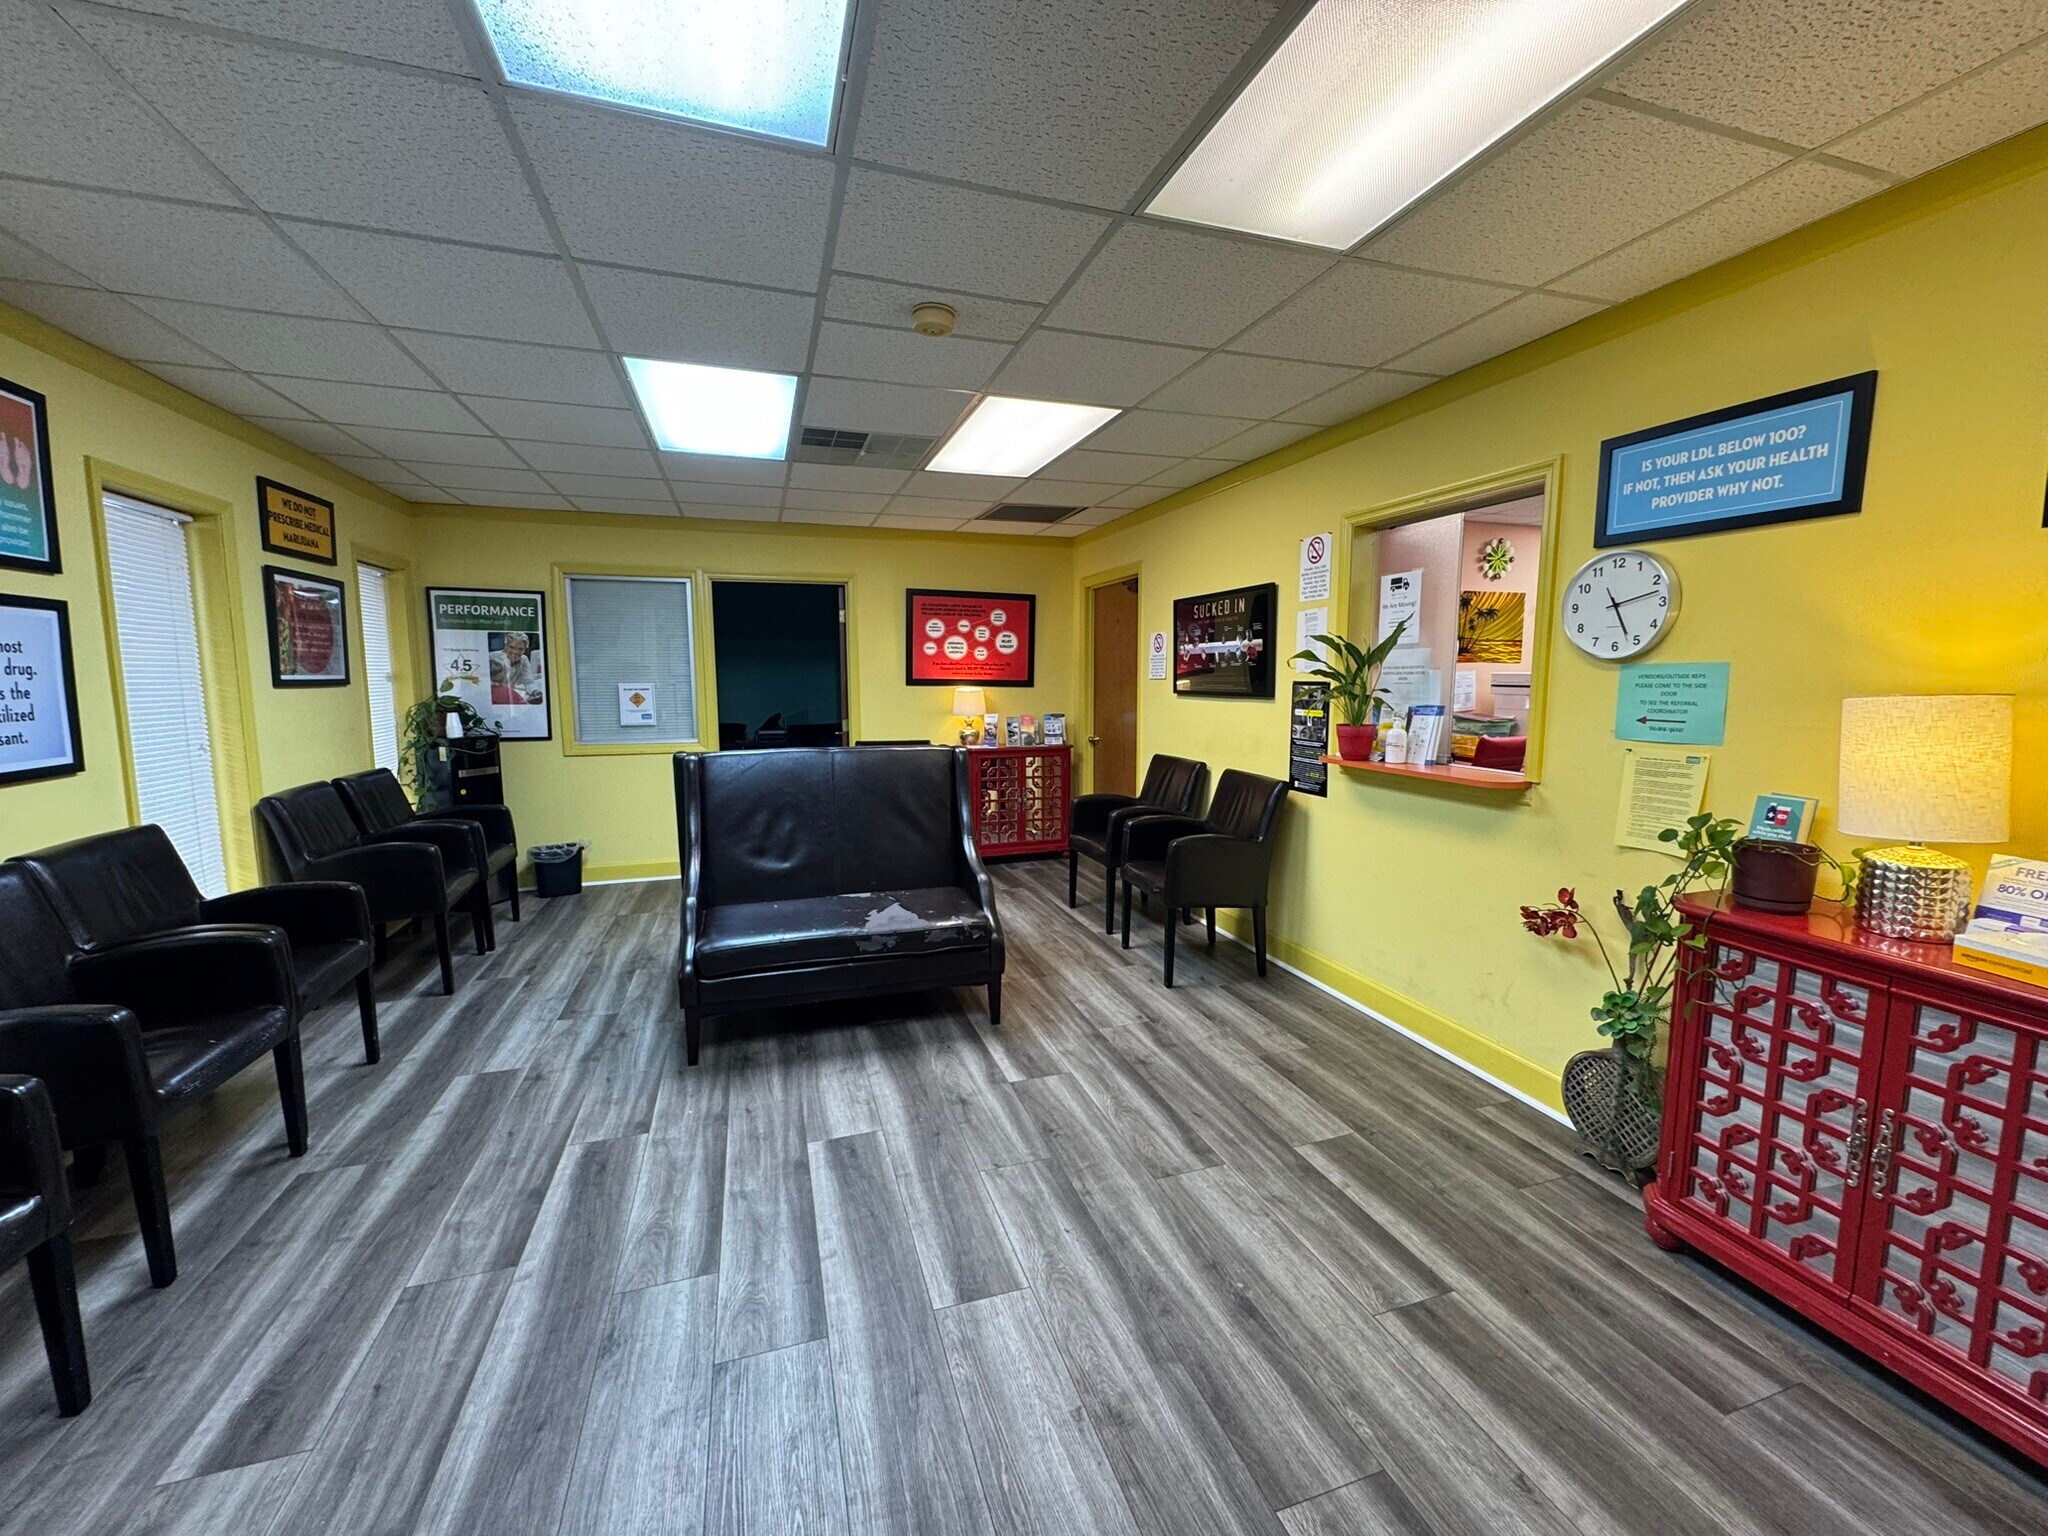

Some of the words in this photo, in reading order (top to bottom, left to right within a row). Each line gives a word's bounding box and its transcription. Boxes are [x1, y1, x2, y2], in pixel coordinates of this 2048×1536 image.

[1642, 460, 1652, 472] IS
[1655, 452, 1688, 470] YOUR
[1691, 447, 1715, 463] LDL
[1718, 433, 1767, 457] BELOW
[1769, 424, 1807, 446] 100?
[1623, 482, 1633, 495] IF
[1635, 478, 1661, 493] NOT,
[1664, 470, 1695, 488] THEN
[1698, 464, 1724, 481] ASK
[1727, 455, 1766, 476] YOUR
[1769, 442, 1829, 468] HEALTH
[1651, 488, 1714, 509] PROVIDER
[1717, 480, 1750, 498] WHY
[1752, 474, 1784, 492] NOT.
[282, 498, 293, 511] WE
[293, 501, 303, 513] DO
[304, 505, 316, 518] NOT
[268, 510, 304, 530] PRESCRIBE
[304, 521, 330, 537] MEDICAL
[283, 531, 320, 550] MARIJUANA
[1593, 567, 1604, 578] 11
[1612, 558, 1626, 569] 12
[1637, 561, 1643, 571] 1
[1578, 583, 1591, 594] 10
[1652, 574, 1661, 585] 2
[439, 604, 536, 617] PERFORMANCE
[1193, 600, 1230, 619] SUCKED
[1234, 598, 1245, 613] IN
[1398, 600, 1417, 608] Moving!
[1571, 603, 1579, 614] 9
[1658, 596, 1667, 607] 3
[1577, 623, 1584, 633] 8
[1650, 619, 1658, 629] 4
[1592, 637, 1599, 647] 7
[1611, 641, 1619, 652] 6
[1633, 635, 1641, 645] 5
[4, 657, 37, 680] drug.
[450, 659, 473, 672] 4.5
[10, 681, 31, 700] the
[2015, 866, 2048, 881] FRE
[1997, 883, 2027, 897] 80%
